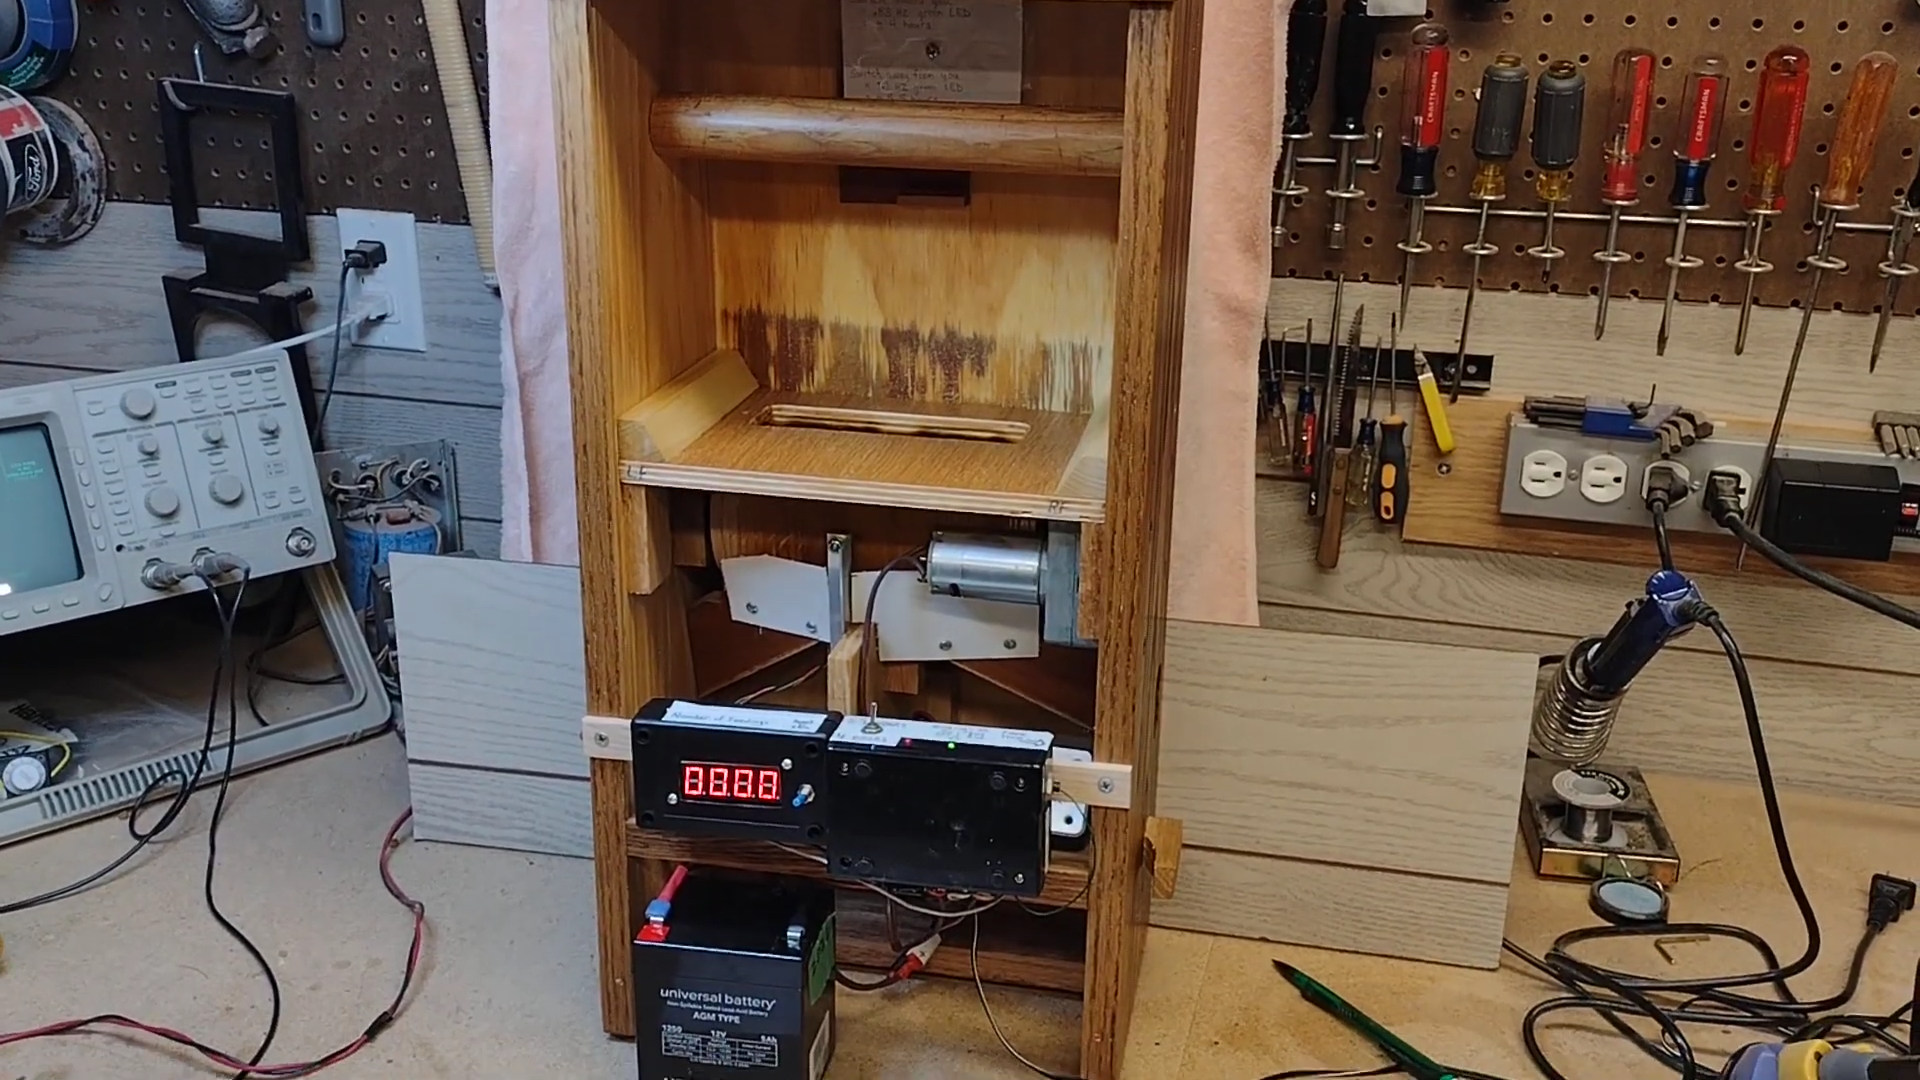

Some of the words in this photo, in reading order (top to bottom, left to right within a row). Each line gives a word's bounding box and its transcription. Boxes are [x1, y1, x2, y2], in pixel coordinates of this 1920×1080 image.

[948, 7, 971, 18] LED
[903, 20, 931, 30] hours
[1427, 71, 1439, 123] CRAFTSMAN
[1694, 88, 1711, 142] CRAFTSMAN
[28, 154, 42, 193] Ford
[1048, 499, 1065, 515] RF
[660, 988, 722, 1004] universal
[724, 993, 777, 1011] battery
[693, 1011, 716, 1021] AGM
[717, 1013, 741, 1024] TYPE
[710, 1029, 727, 1038] 12V
